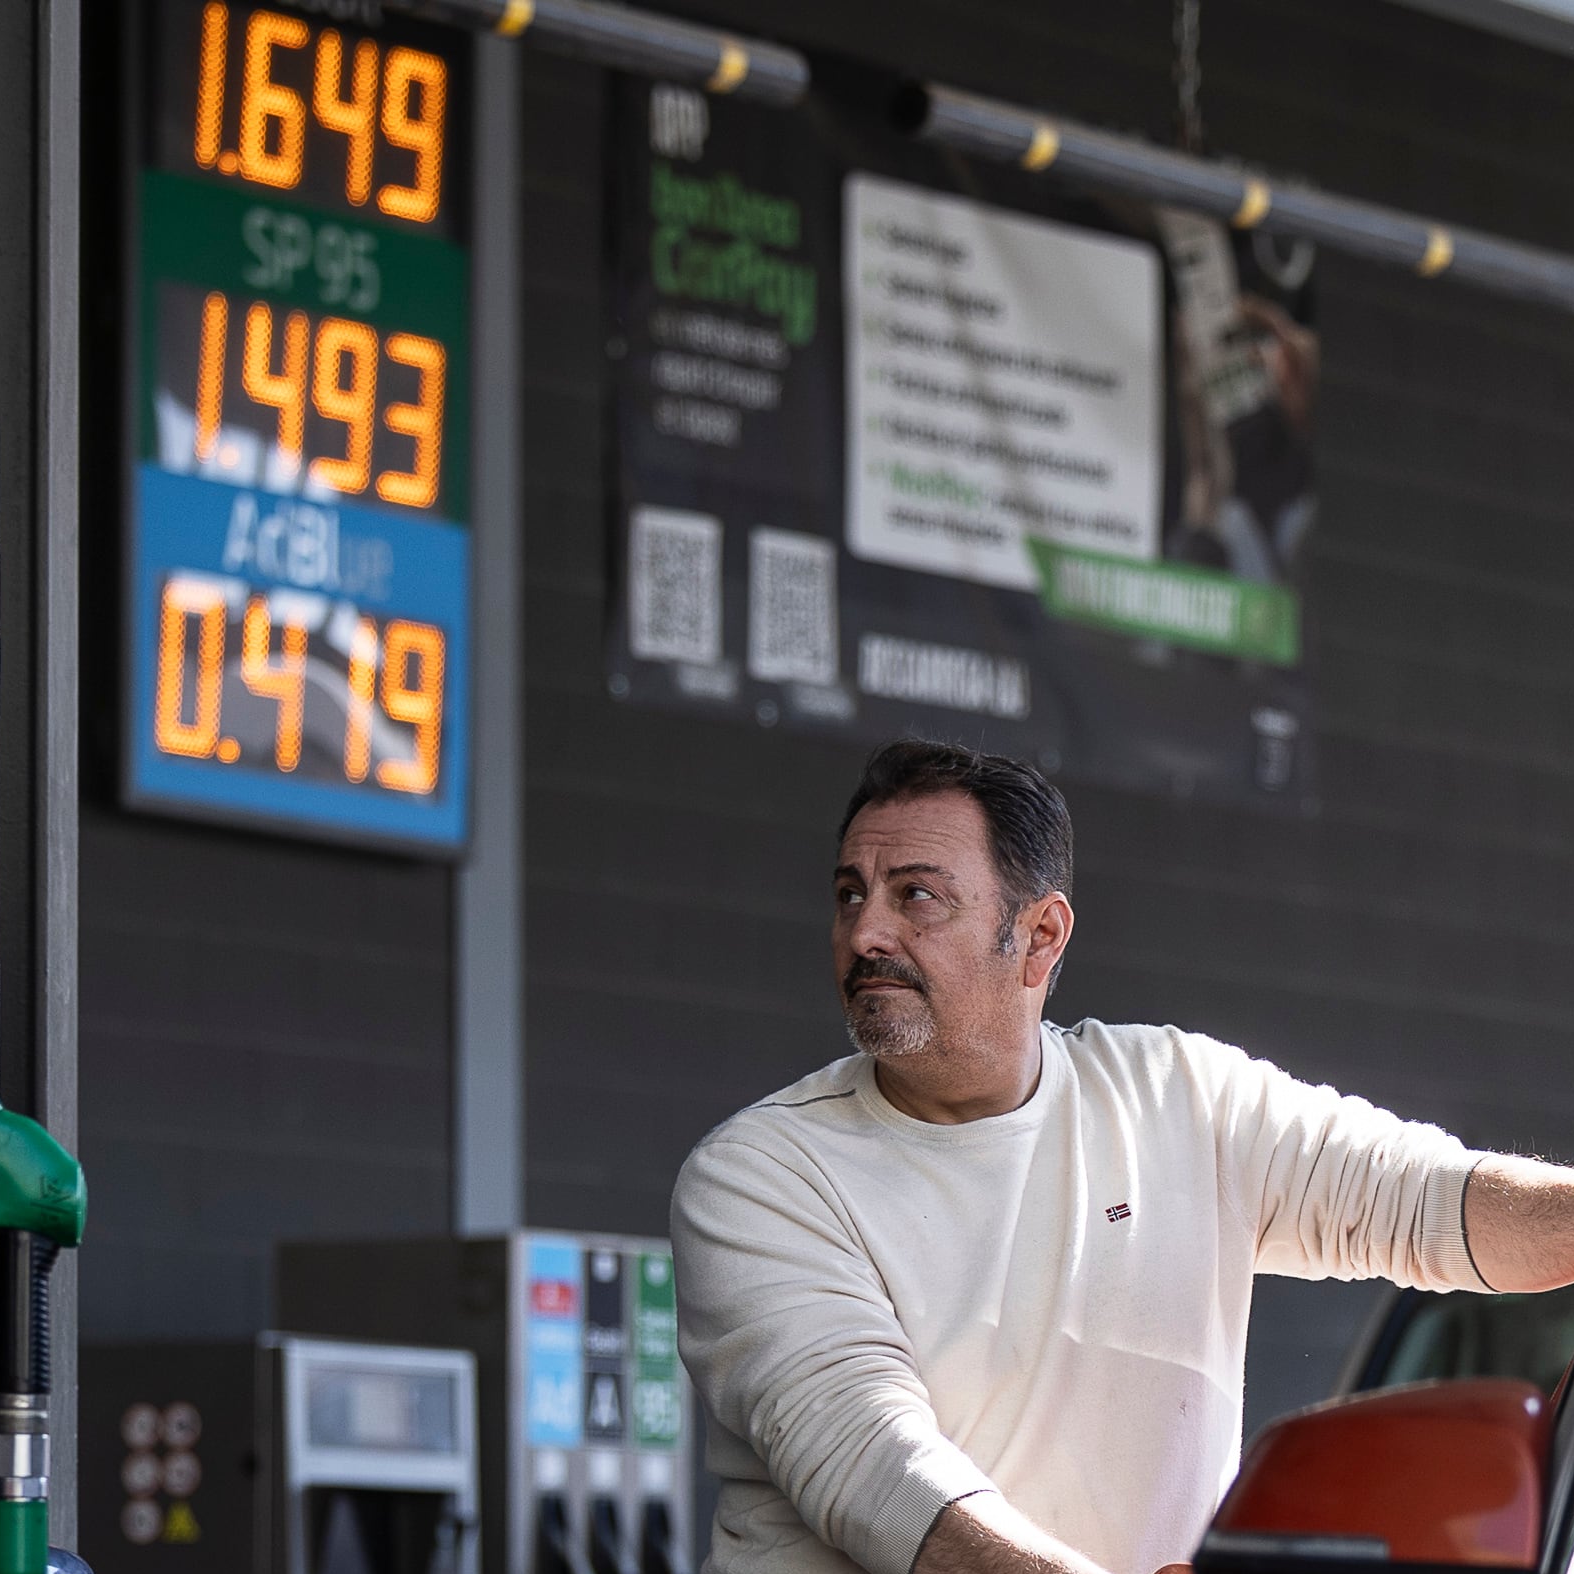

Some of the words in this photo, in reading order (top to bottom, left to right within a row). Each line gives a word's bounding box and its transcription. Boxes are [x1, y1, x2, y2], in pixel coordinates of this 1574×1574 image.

[194, 0, 447, 223] 1.649
[241, 206, 313, 291] SP
[314, 222, 381, 314] 95
[194, 291, 446, 508] 1.493
[154, 578, 445, 794] 0.419
